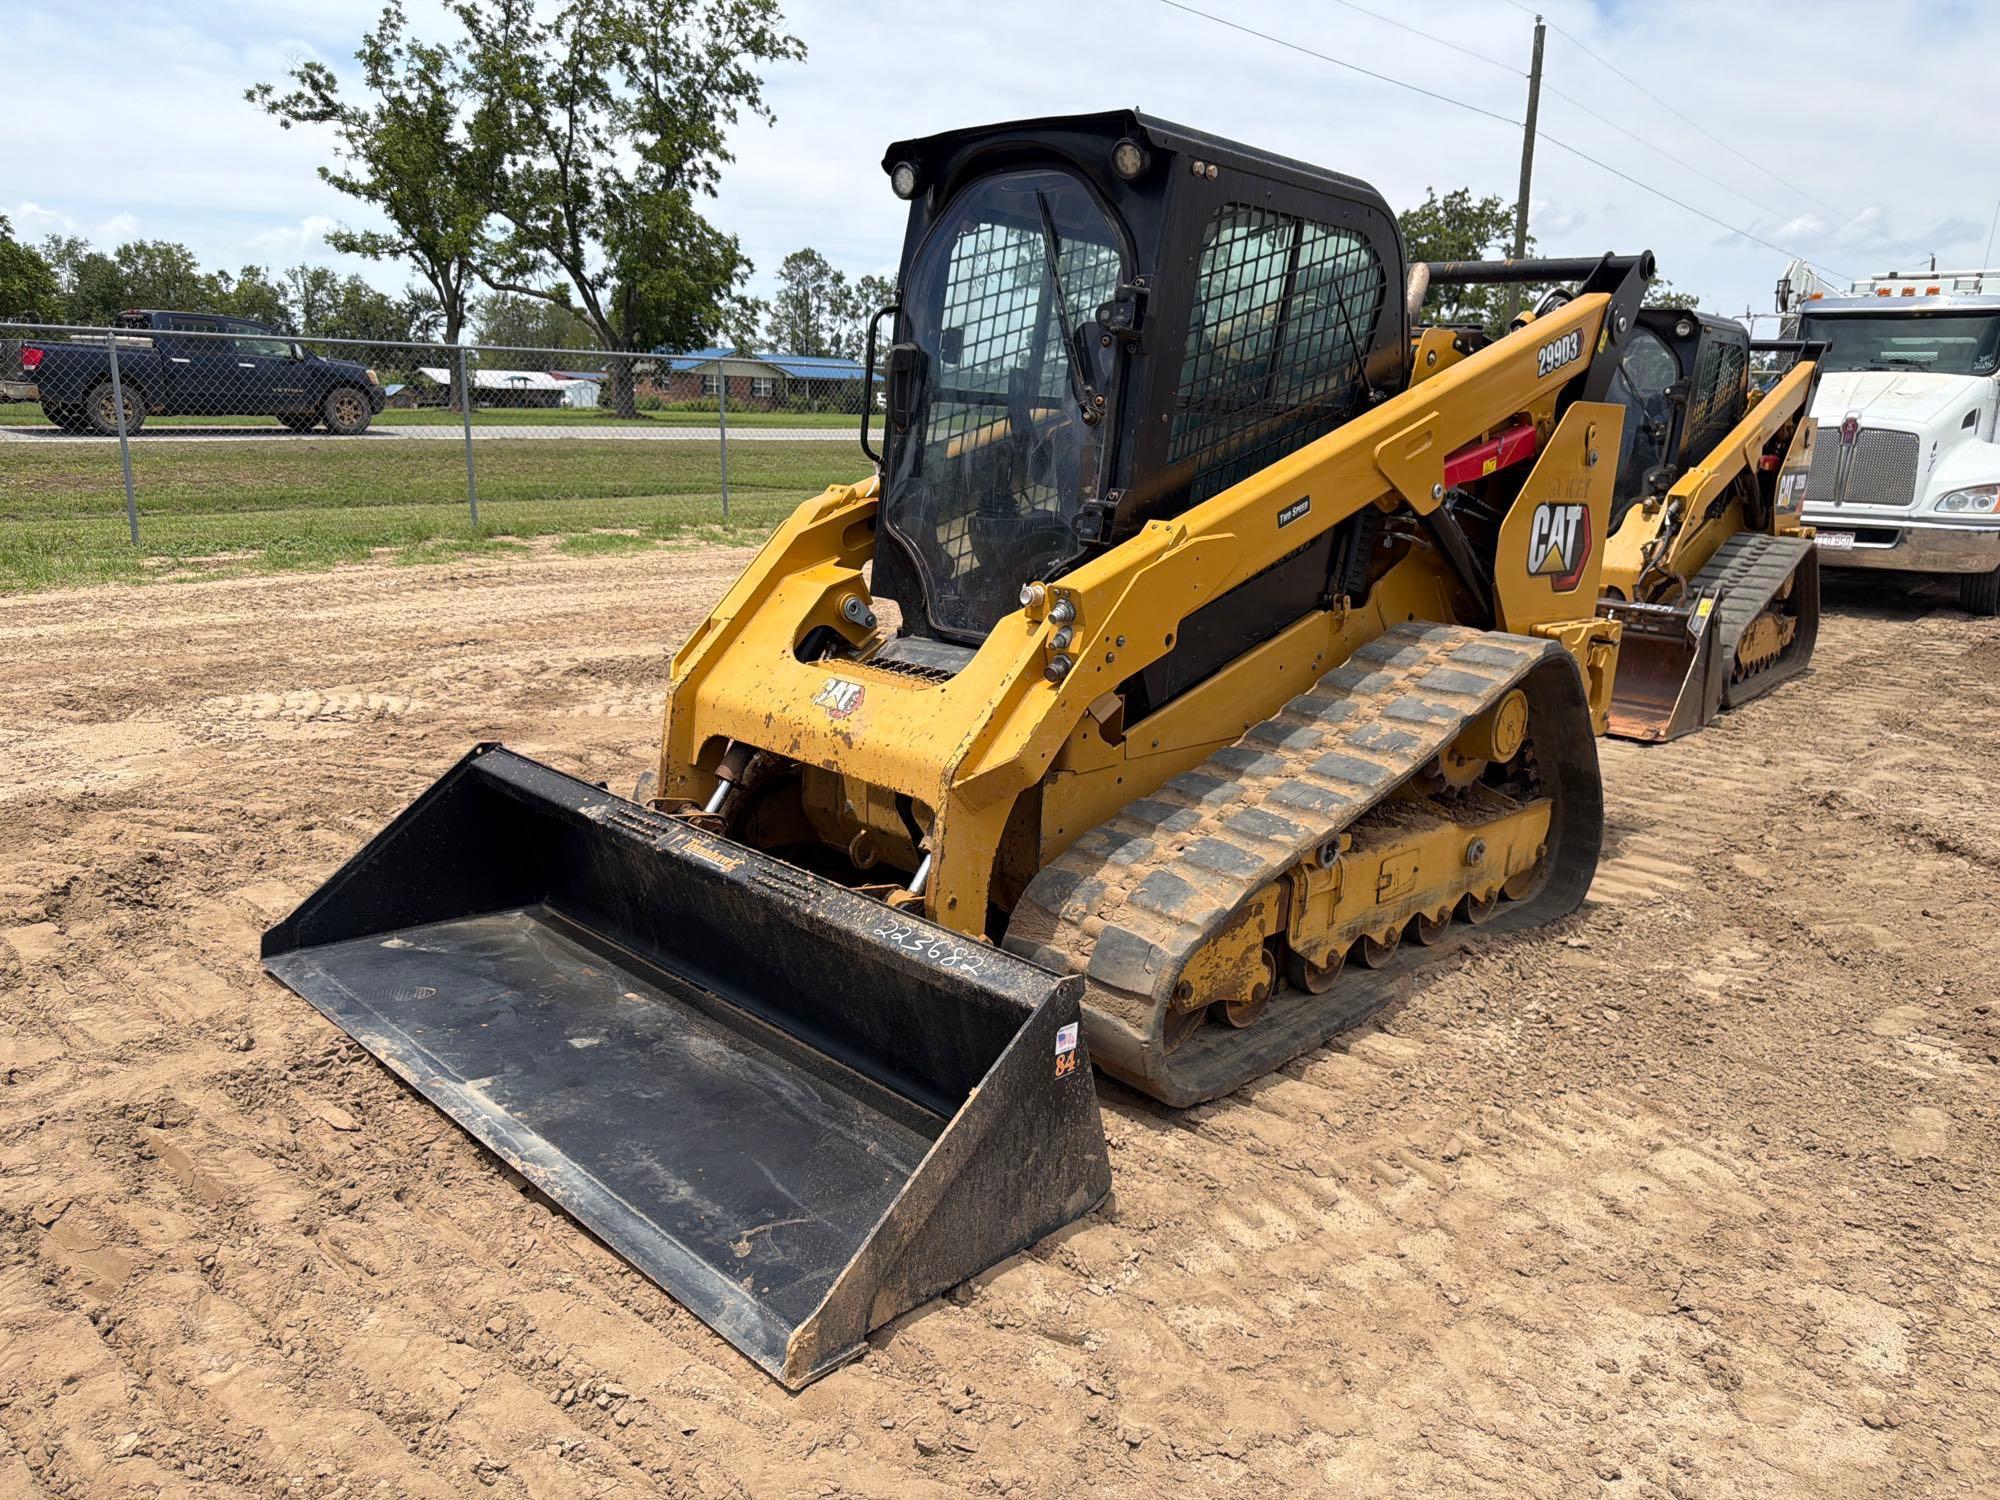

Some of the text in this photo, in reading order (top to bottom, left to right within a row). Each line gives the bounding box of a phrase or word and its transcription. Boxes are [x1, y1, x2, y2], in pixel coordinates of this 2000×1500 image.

[1537, 331, 1578, 377] 299D3
[1777, 474, 1796, 507] CAT
[1528, 504, 1583, 574] CAT
[873, 918, 984, 977] 223682
[1055, 1050, 1076, 1077] 84
